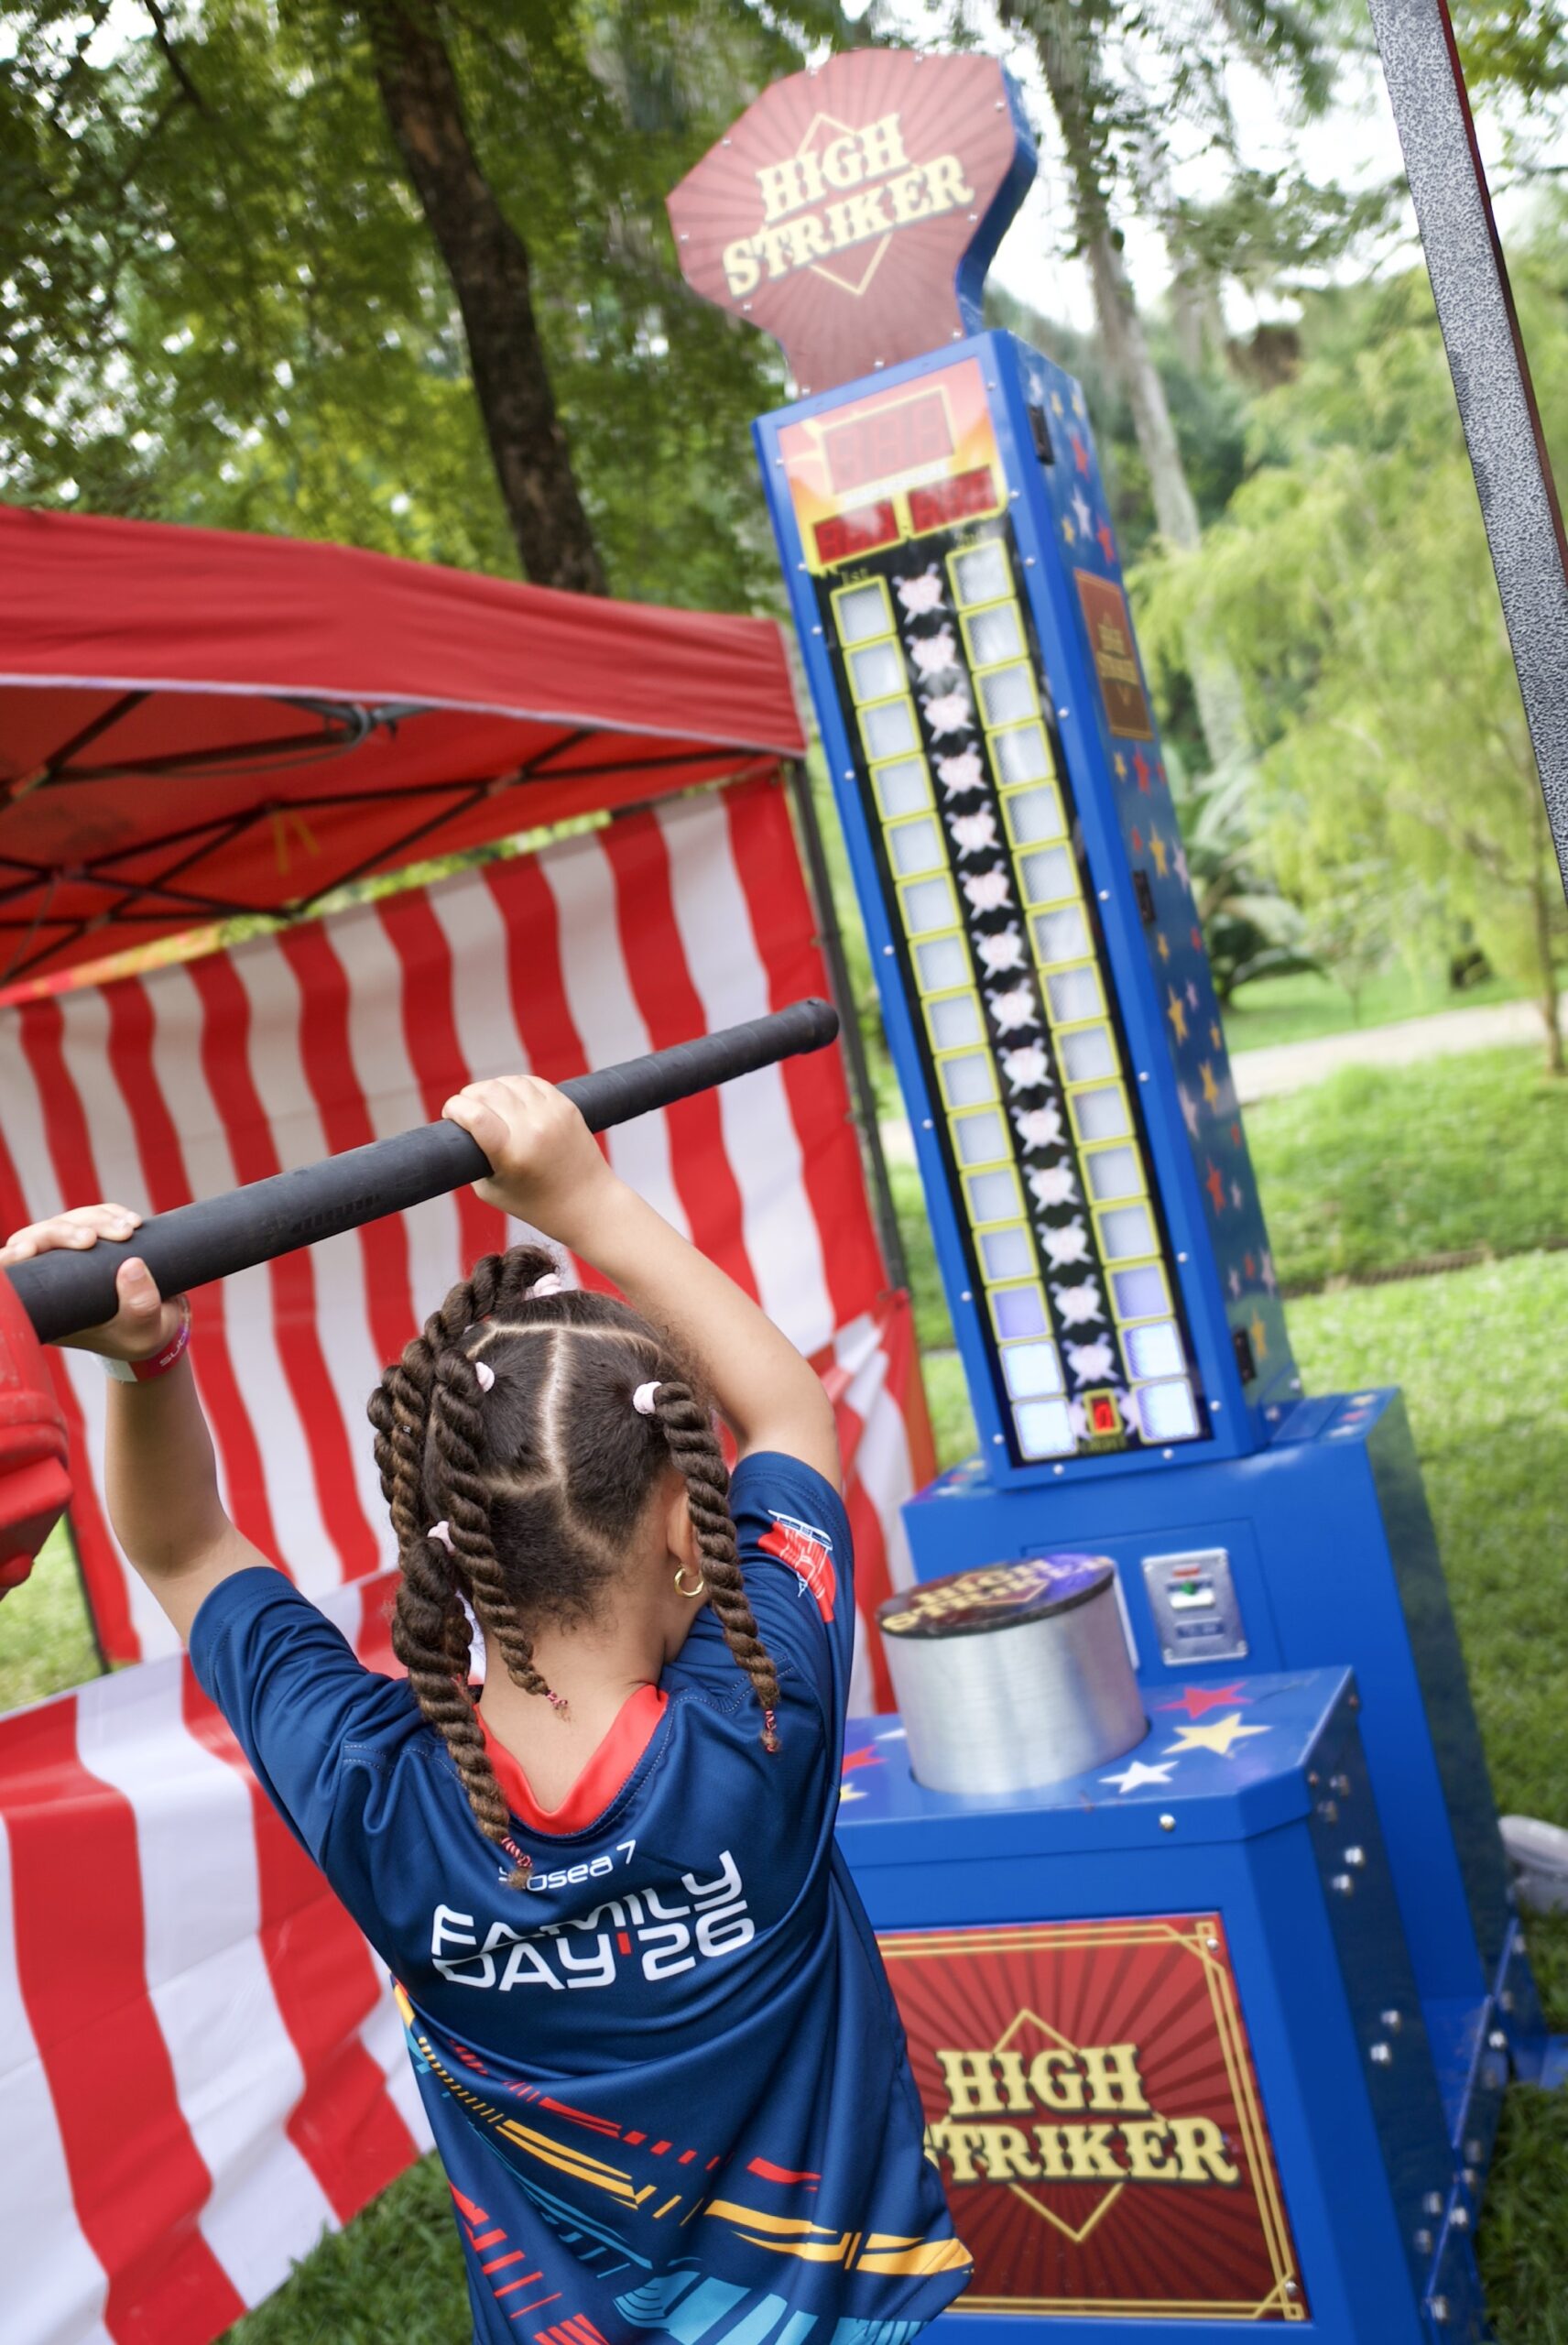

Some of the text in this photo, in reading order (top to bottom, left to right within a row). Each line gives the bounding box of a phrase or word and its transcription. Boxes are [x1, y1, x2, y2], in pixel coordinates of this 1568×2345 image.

[756, 112, 910, 224] HIGH
[722, 154, 975, 297] STRIKER
[615, 1838, 637, 1865] 7
[431, 1849, 743, 1957] FAMILY
[431, 1899, 756, 1992] DAY'26
[937, 2044, 1153, 2116] HIGH
